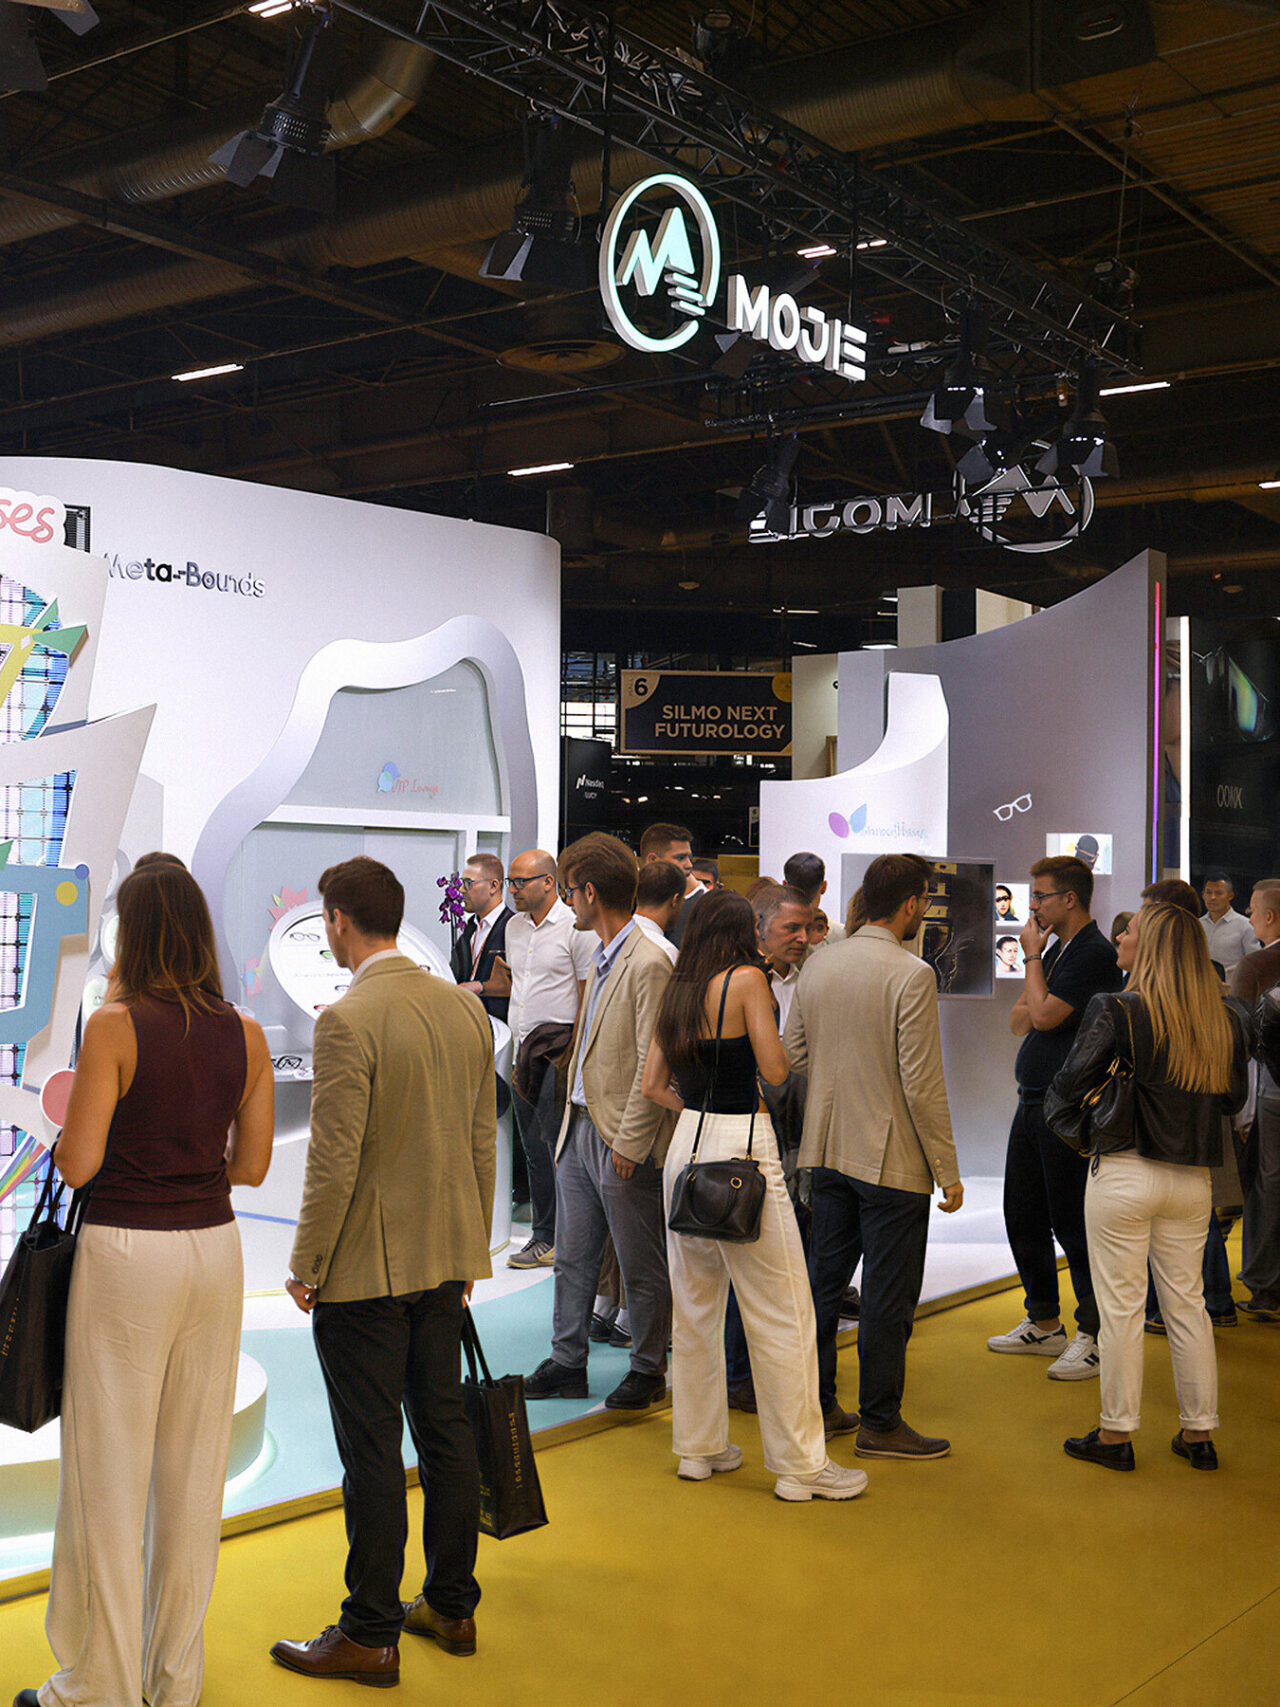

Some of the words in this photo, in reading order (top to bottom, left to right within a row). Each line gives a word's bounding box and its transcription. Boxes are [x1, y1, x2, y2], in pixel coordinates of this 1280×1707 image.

[727, 273, 867, 381] MOJIE
[633, 677, 649, 697] 6
[661, 704, 722, 721] SILMO
[726, 705, 778, 721] NEXT
[655, 722, 785, 739] FUTUROLOGY
